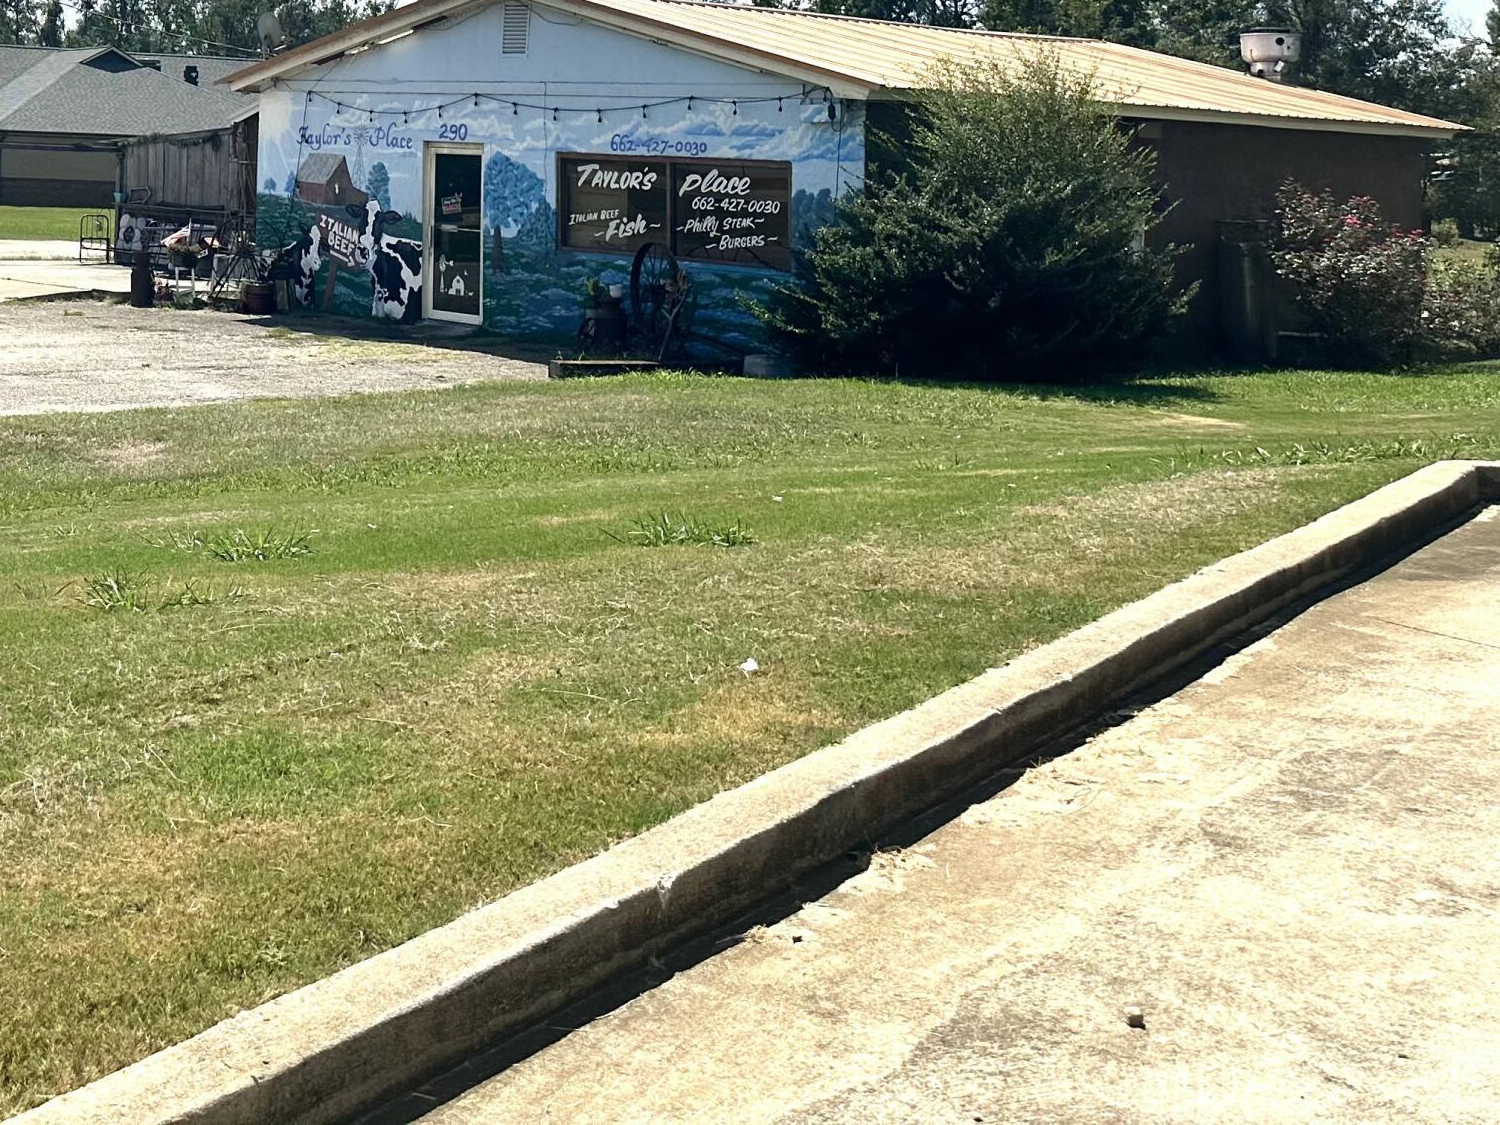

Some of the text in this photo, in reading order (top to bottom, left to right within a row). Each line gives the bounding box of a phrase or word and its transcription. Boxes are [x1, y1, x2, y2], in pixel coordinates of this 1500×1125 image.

[296, 122, 413, 151] Taylor's Place
[438, 123, 468, 141] 290
[610, 133, 708, 156] 662-427-0030
[600, 209, 620, 220] BEEF
[691, 196, 781, 214] 662-427-0030
[320, 214, 360, 245] ITALIAN
[327, 230, 355, 256] BEEF
